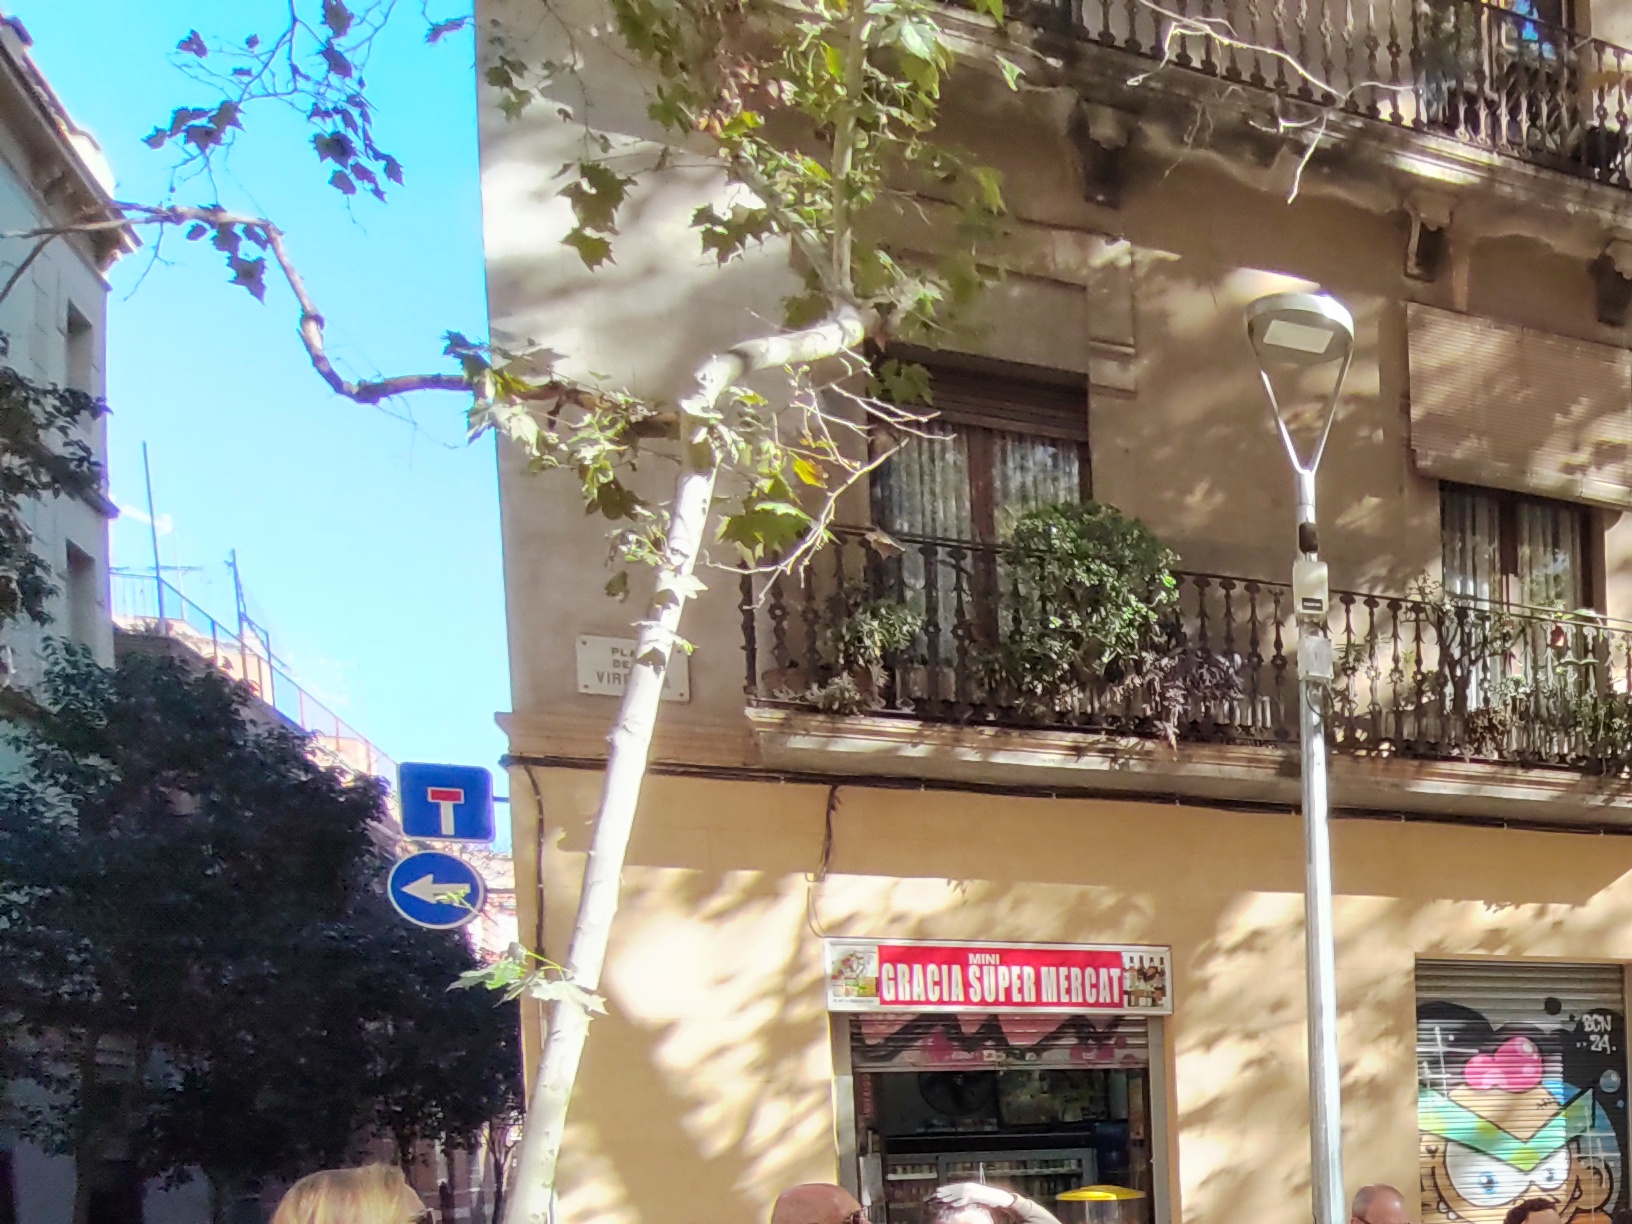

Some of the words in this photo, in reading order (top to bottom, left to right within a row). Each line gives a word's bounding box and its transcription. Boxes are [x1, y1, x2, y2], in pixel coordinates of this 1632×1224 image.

[968, 952, 1000, 965] MINI
[881, 962, 965, 1002] GRACIA
[968, 965, 1036, 1003] SUPER
[1040, 966, 1122, 1004] MERCAT
[1582, 1013, 1612, 1032] BCN
